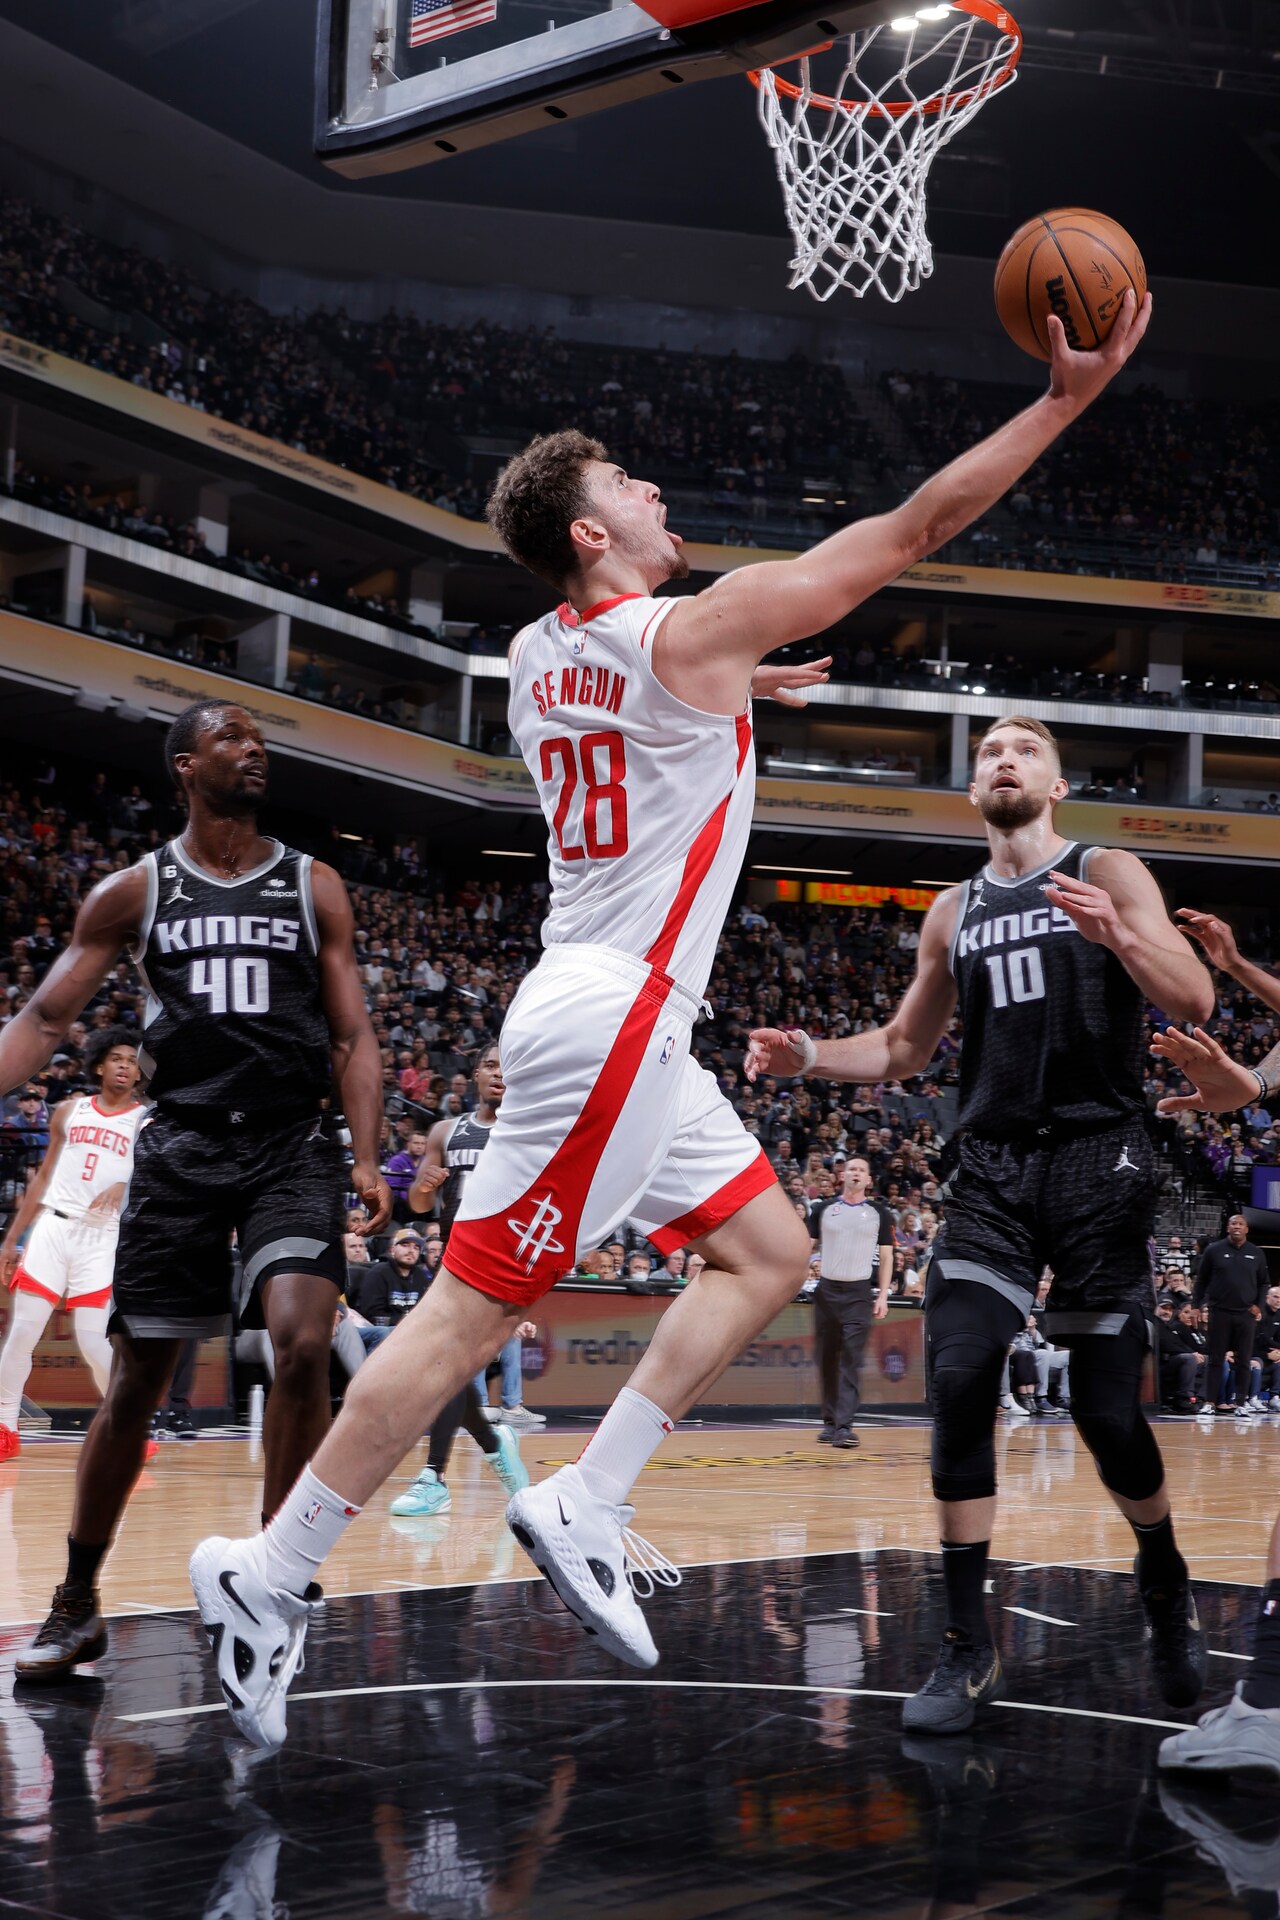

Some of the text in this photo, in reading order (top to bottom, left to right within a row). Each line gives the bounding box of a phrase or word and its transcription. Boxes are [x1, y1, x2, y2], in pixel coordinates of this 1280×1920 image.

[531, 665, 626, 717] SENGUN
[539, 730, 629, 861] 28
[163, 865, 178, 879] 6
[260, 889, 298, 898] dialpad
[155, 915, 300, 954] KINGS
[957, 906, 1079, 958] KINGS
[189, 957, 270, 1013] 40
[985, 946, 1046, 1009] 10
[69, 1125, 130, 1157] ROCKETS
[81, 1152, 99, 1182] 9
